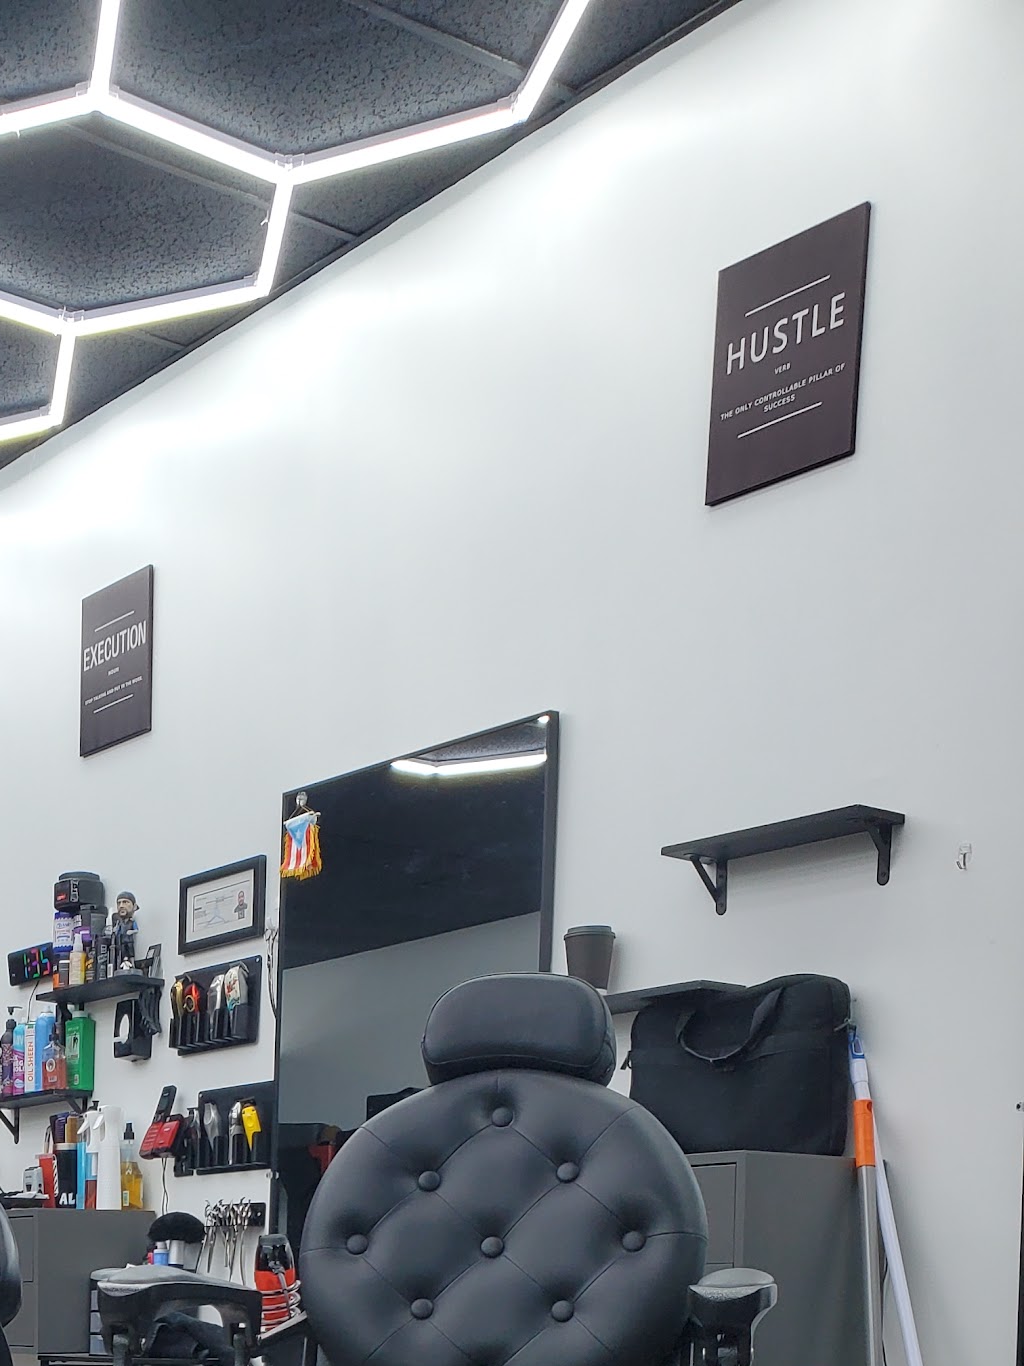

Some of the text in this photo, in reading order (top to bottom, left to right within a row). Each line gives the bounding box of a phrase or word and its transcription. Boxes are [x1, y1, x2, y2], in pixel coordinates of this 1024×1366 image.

[726, 291, 846, 376] HUSTLE
[720, 362, 846, 421] THE ONLY CONTROLLABLE PILLAR OF
[774, 362, 792, 375] VERB
[763, 394, 796, 413] SUCCESS
[83, 620, 147, 672] EXECUTION
